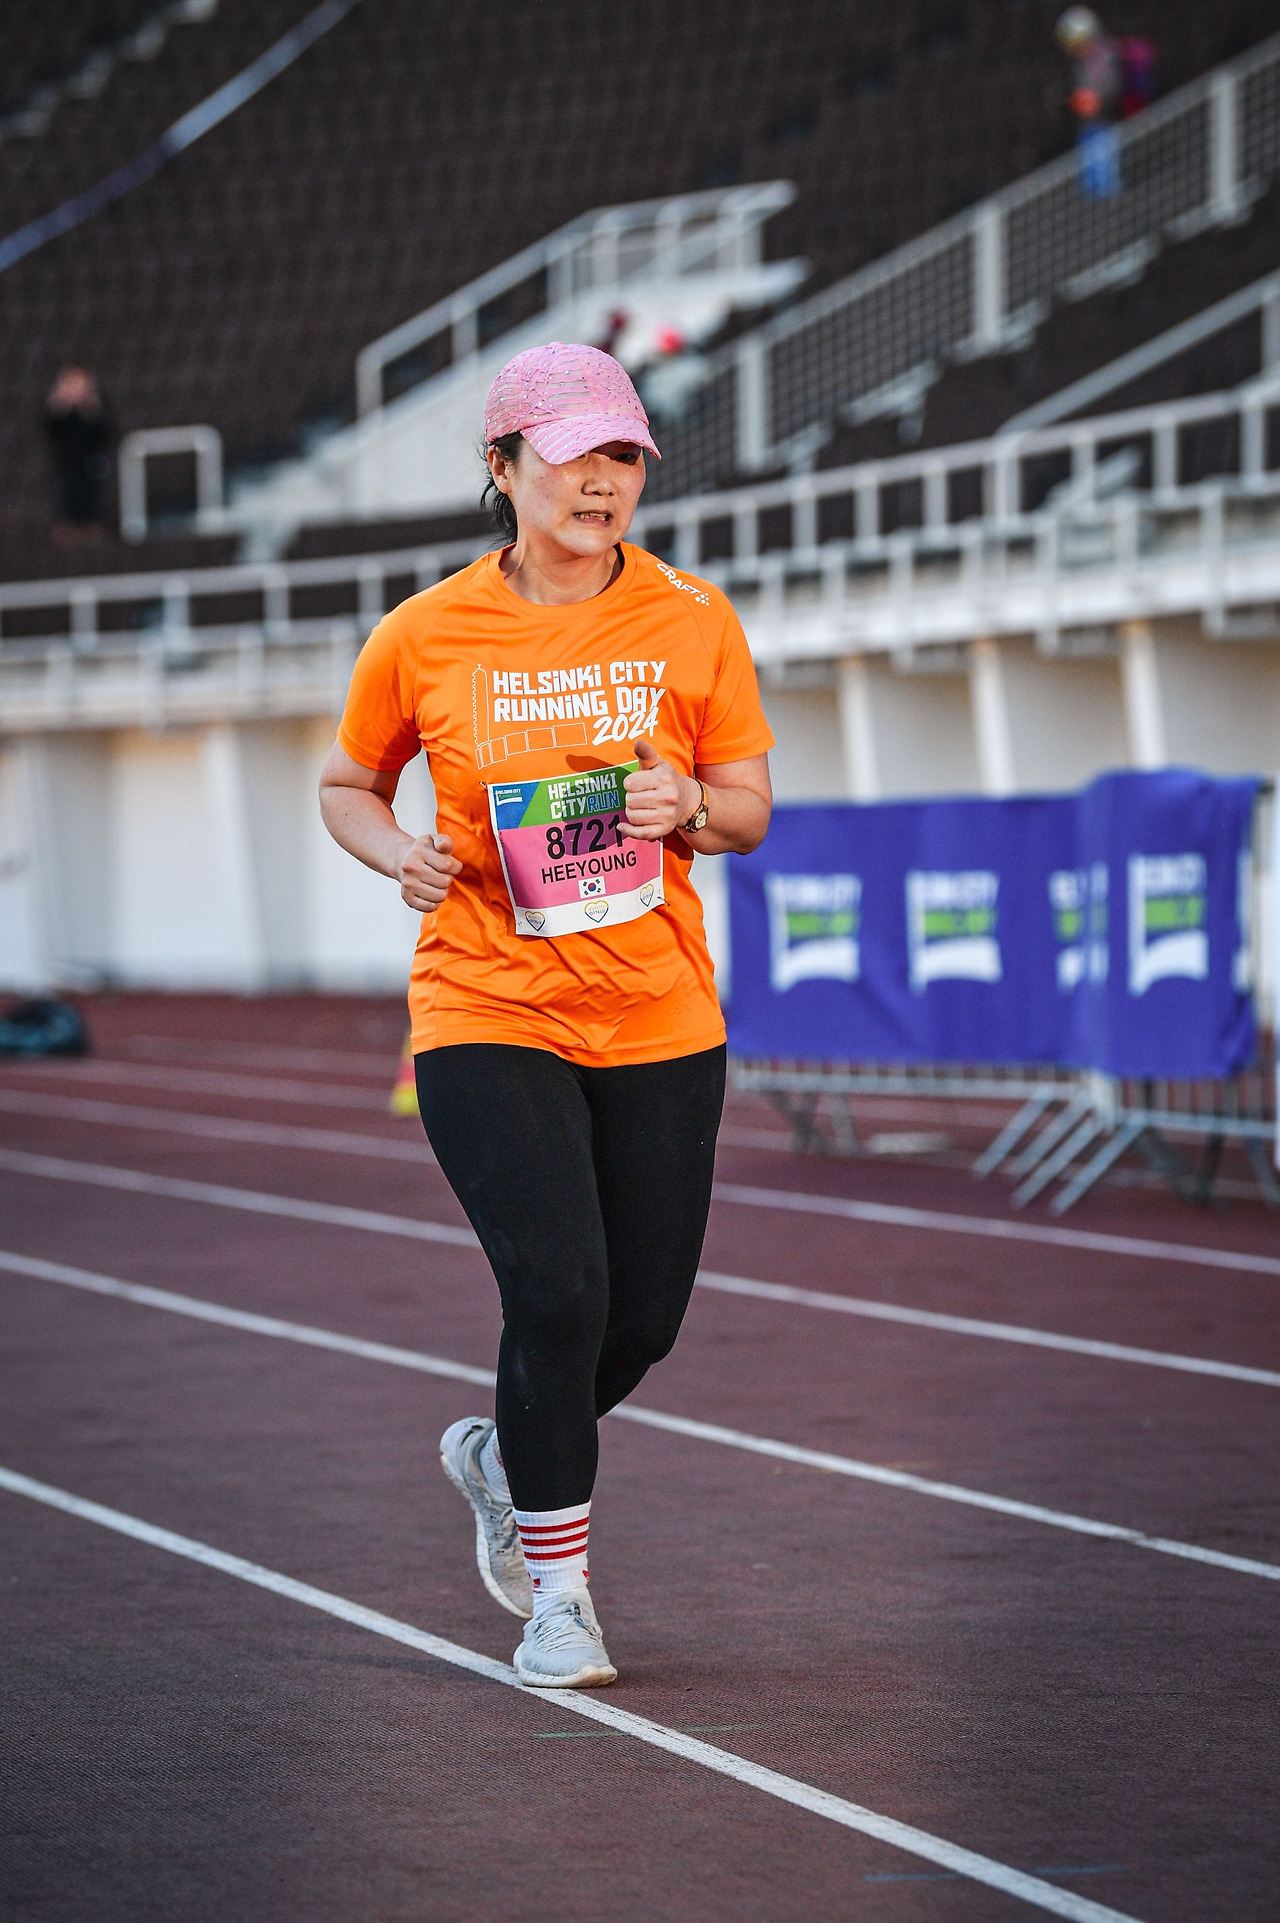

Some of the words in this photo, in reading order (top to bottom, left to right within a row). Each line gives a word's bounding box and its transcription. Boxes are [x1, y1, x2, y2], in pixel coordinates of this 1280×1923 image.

[656, 563, 700, 596] CRAFT
[616, 686, 666, 714] DAY
[592, 706, 659, 746] 2024
[548, 773, 618, 800] HELSINKI
[546, 815, 624, 860] 8721
[541, 851, 637, 884] HEEYOUNG
